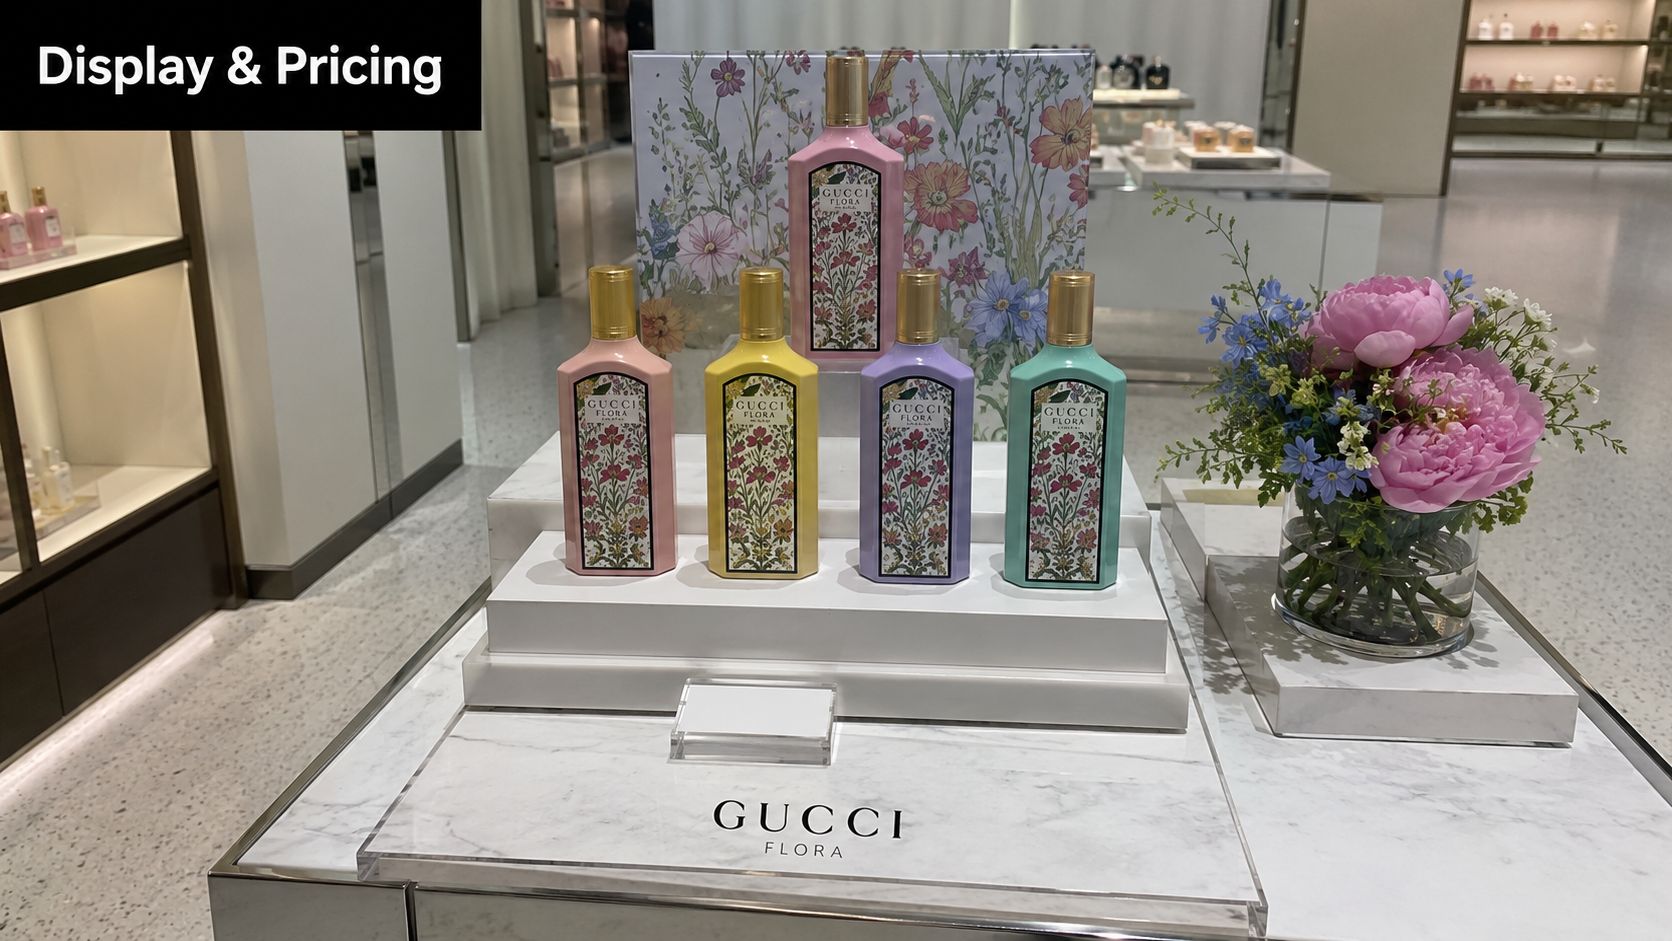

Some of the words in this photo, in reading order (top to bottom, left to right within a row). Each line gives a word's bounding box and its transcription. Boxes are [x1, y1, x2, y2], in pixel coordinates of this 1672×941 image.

[822, 188, 868, 198] GUCCI
[587, 400, 636, 409] GUCCI
[736, 400, 784, 411] GUCCI
[892, 404, 941, 414] GUCCI
[1044, 407, 1094, 417] GUCCI
[713, 799, 902, 839] GUCCI
[764, 841, 843, 859] FLORA
